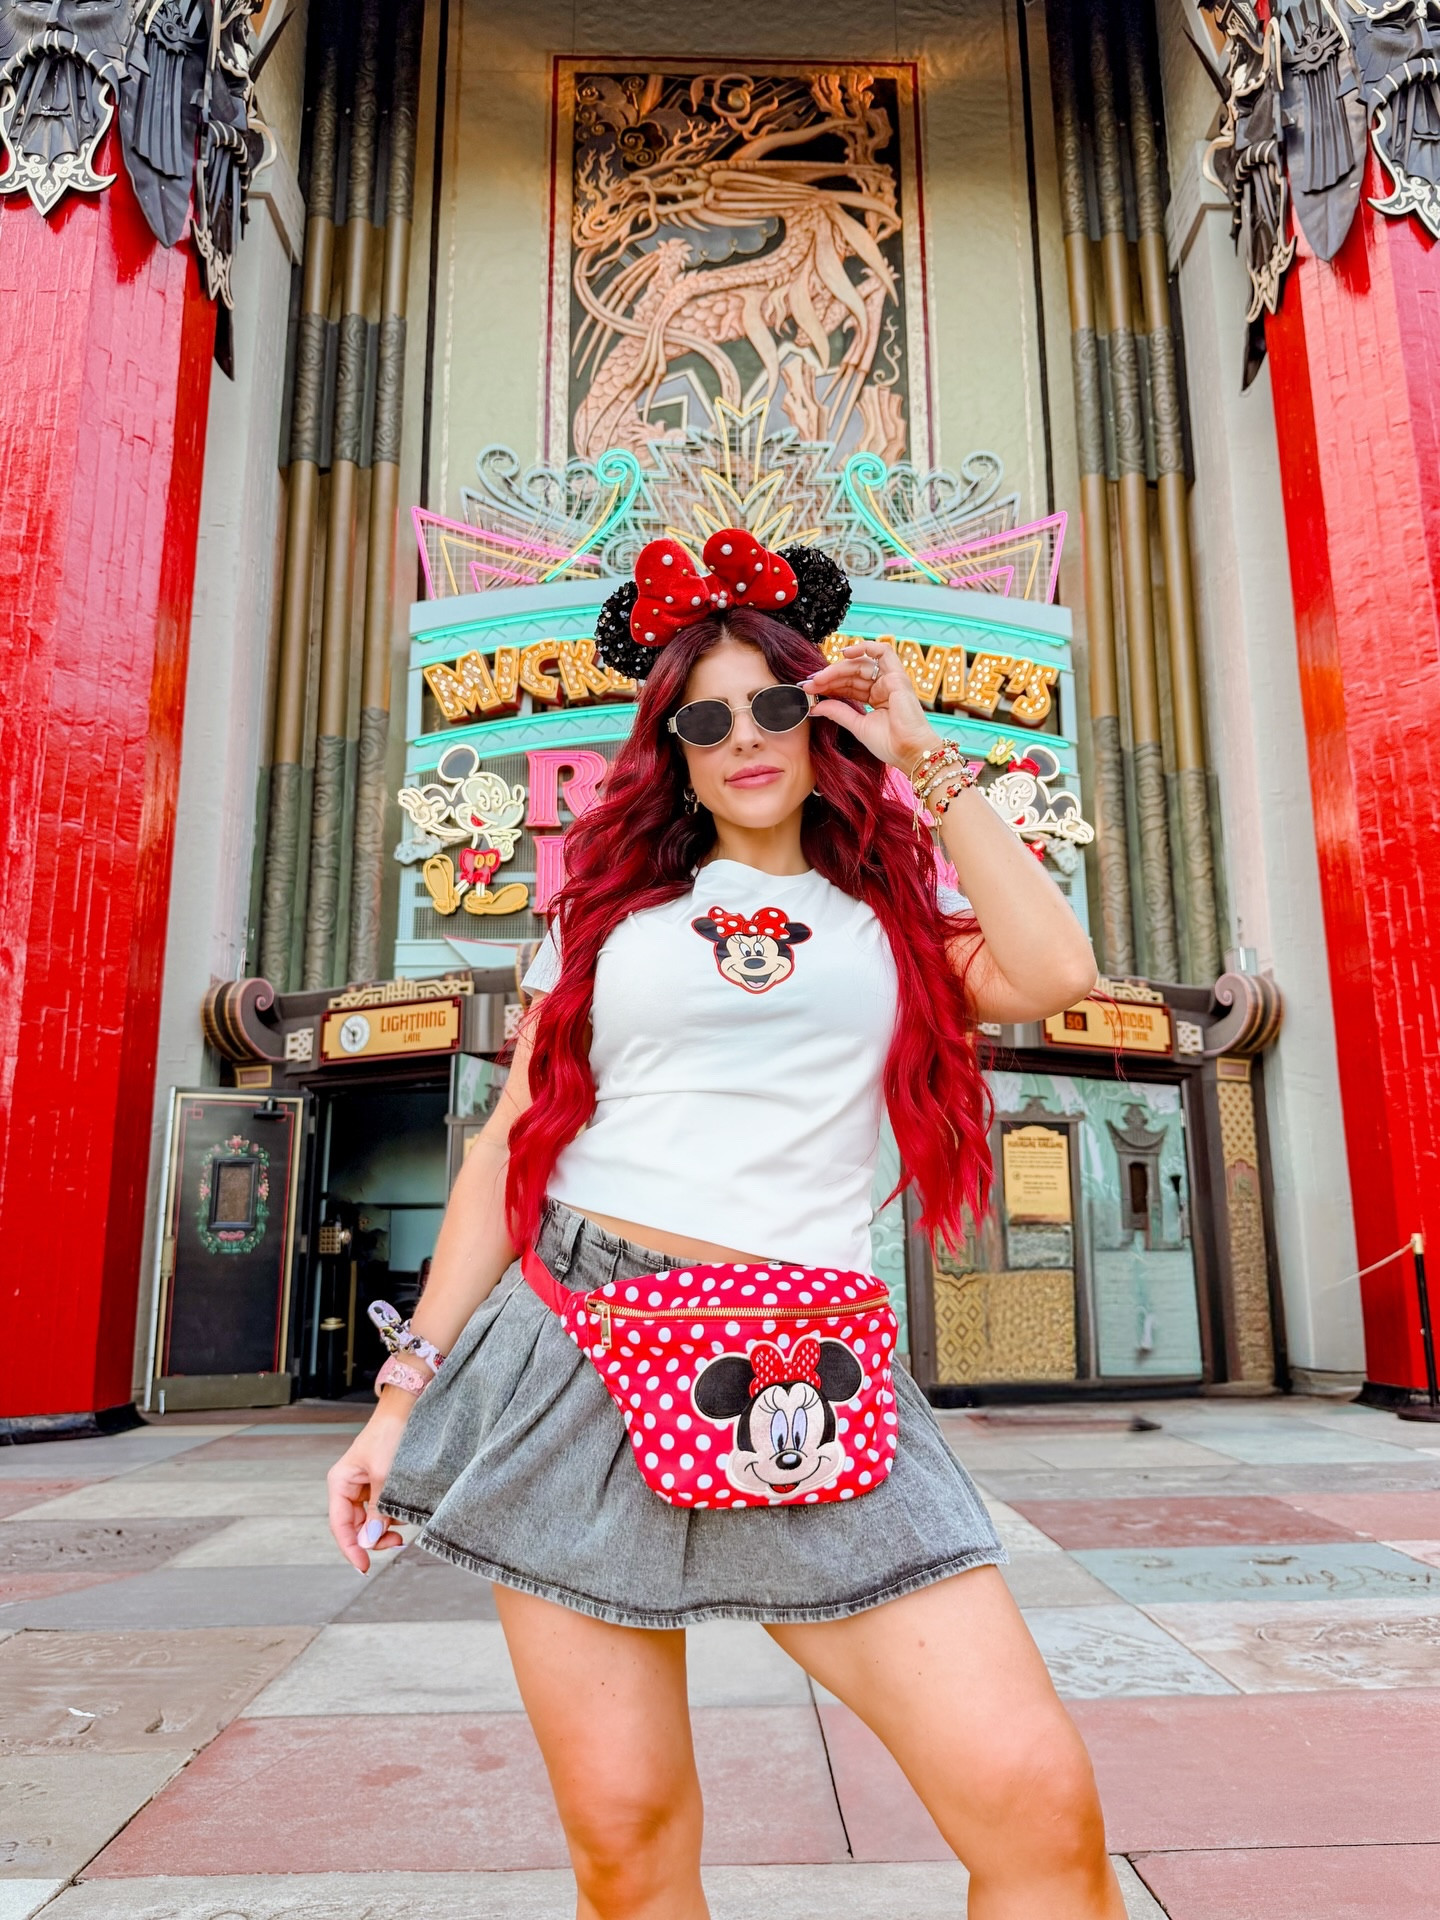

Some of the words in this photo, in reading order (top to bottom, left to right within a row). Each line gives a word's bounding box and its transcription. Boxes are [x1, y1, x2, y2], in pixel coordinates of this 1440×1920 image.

[424, 638, 637, 720] MICK
[381, 1010, 446, 1033] LIGHTNING
[1066, 1014, 1083, 1029] 50
[403, 1032, 421, 1043] LANE
